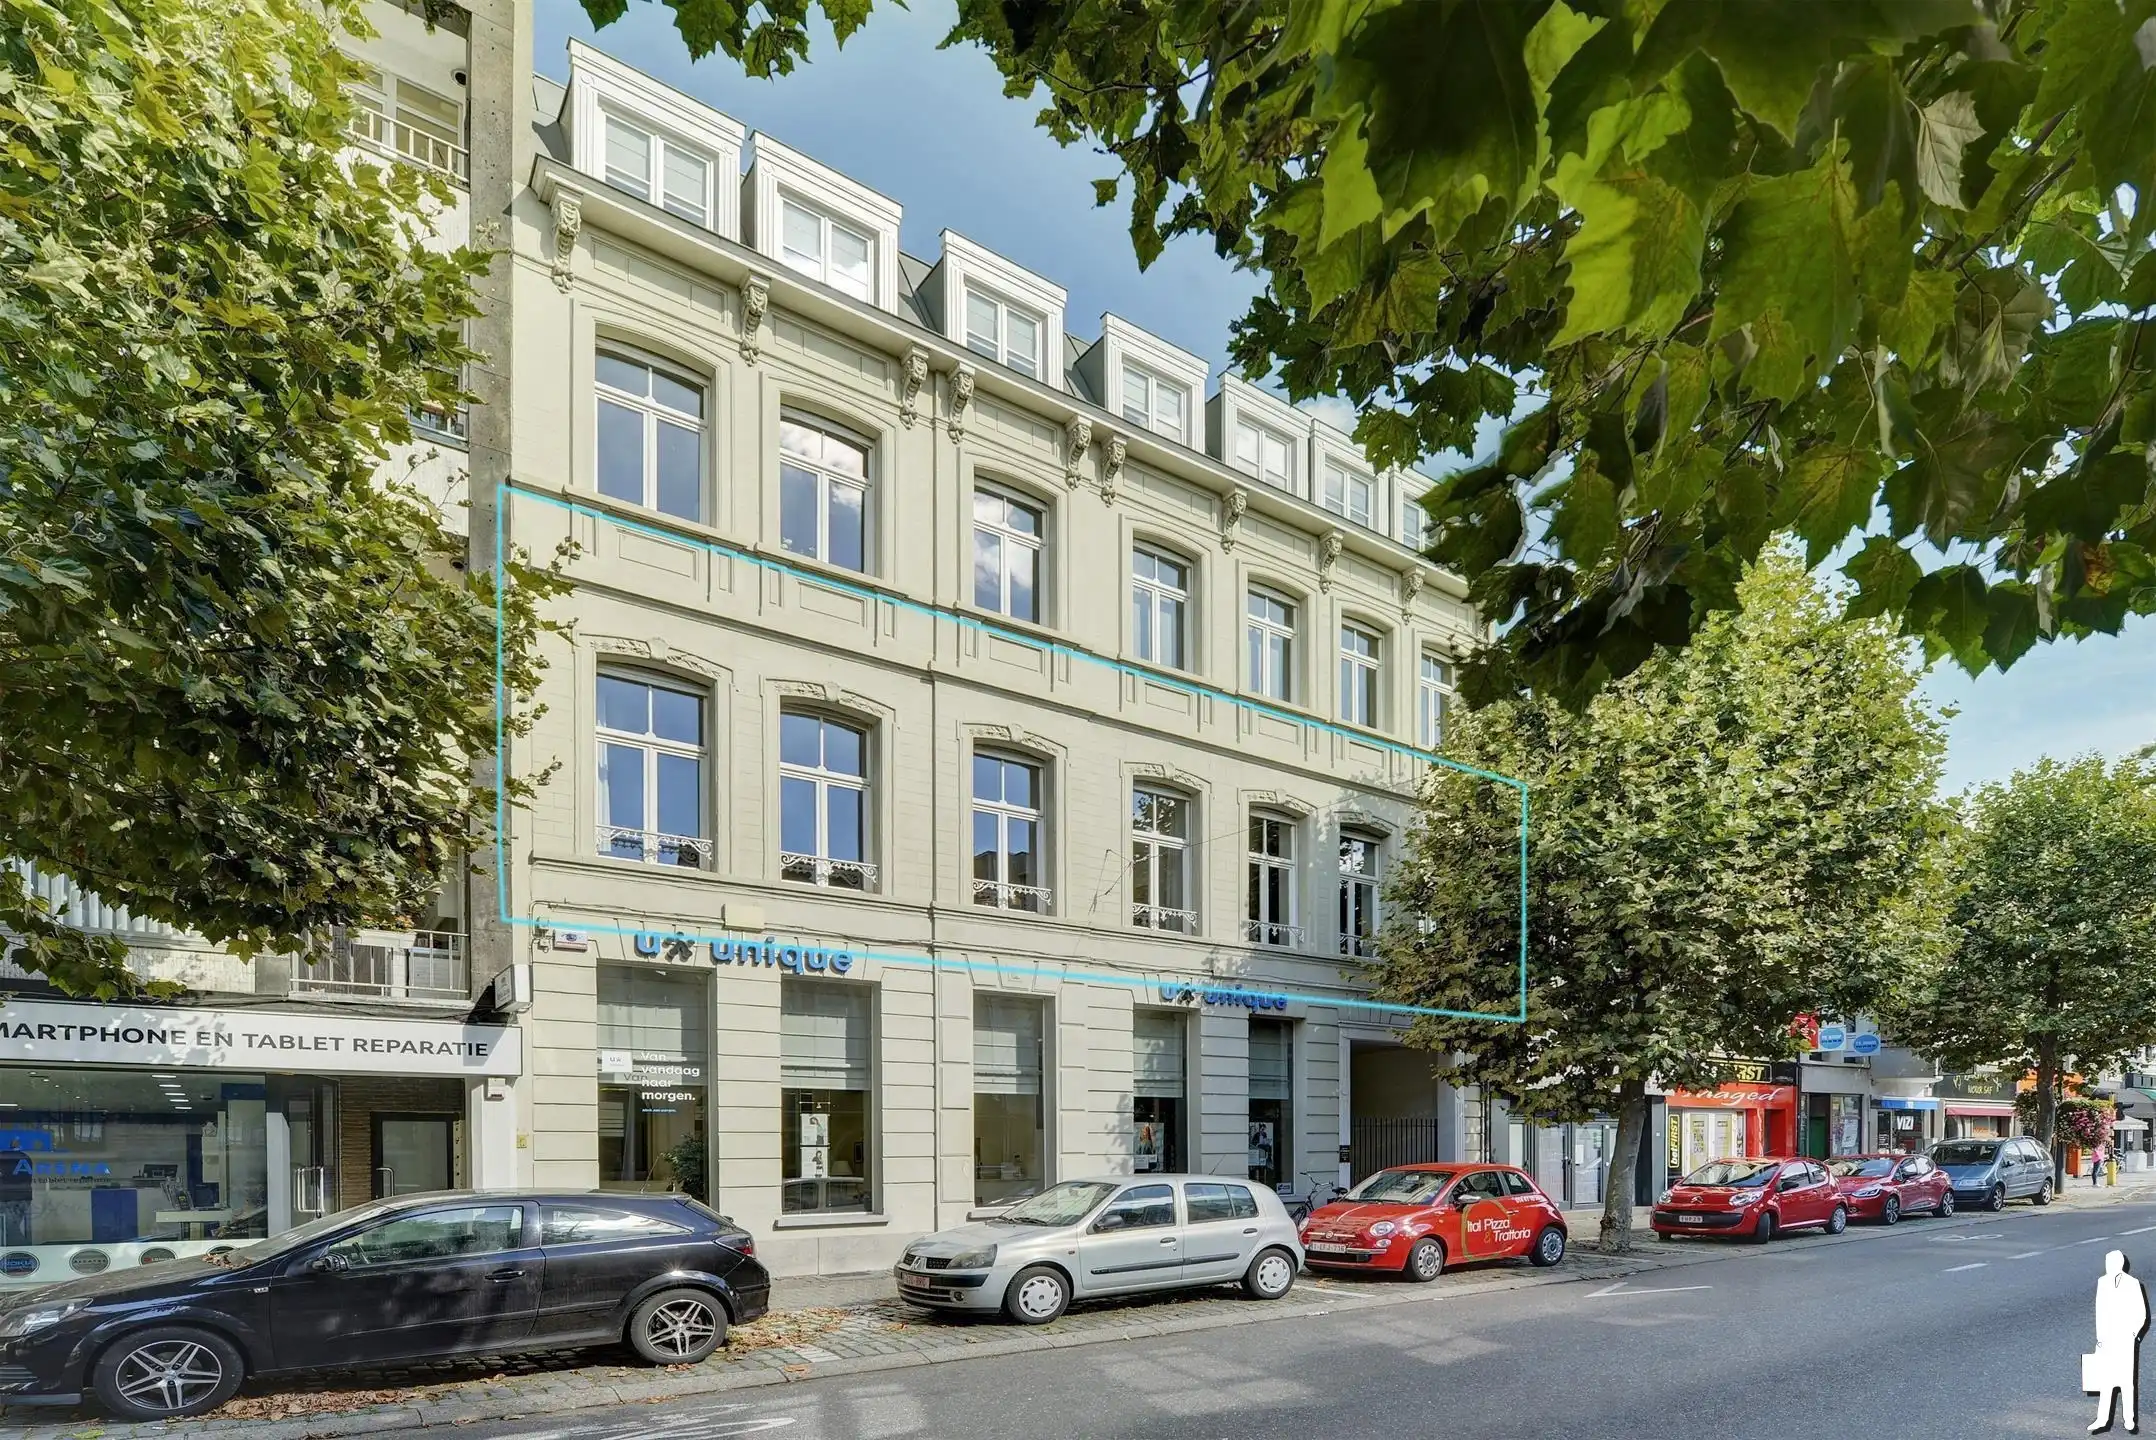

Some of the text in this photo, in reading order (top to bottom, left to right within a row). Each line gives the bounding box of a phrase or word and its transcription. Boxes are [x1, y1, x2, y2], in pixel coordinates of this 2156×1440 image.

[709, 936, 853, 974] unique
[196, 1031, 233, 1048] EN
[242, 1033, 345, 1052] TABLET
[352, 1038, 489, 1057] REPARATIE
[641, 1051, 667, 1062] Van
[641, 1065, 700, 1077] vandaag
[641, 1079, 673, 1088] naar
[641, 1091, 696, 1102] morgen.
[1467, 1218, 1510, 1233] Ital Pizza
[1493, 1227, 1531, 1242] Trattoria
